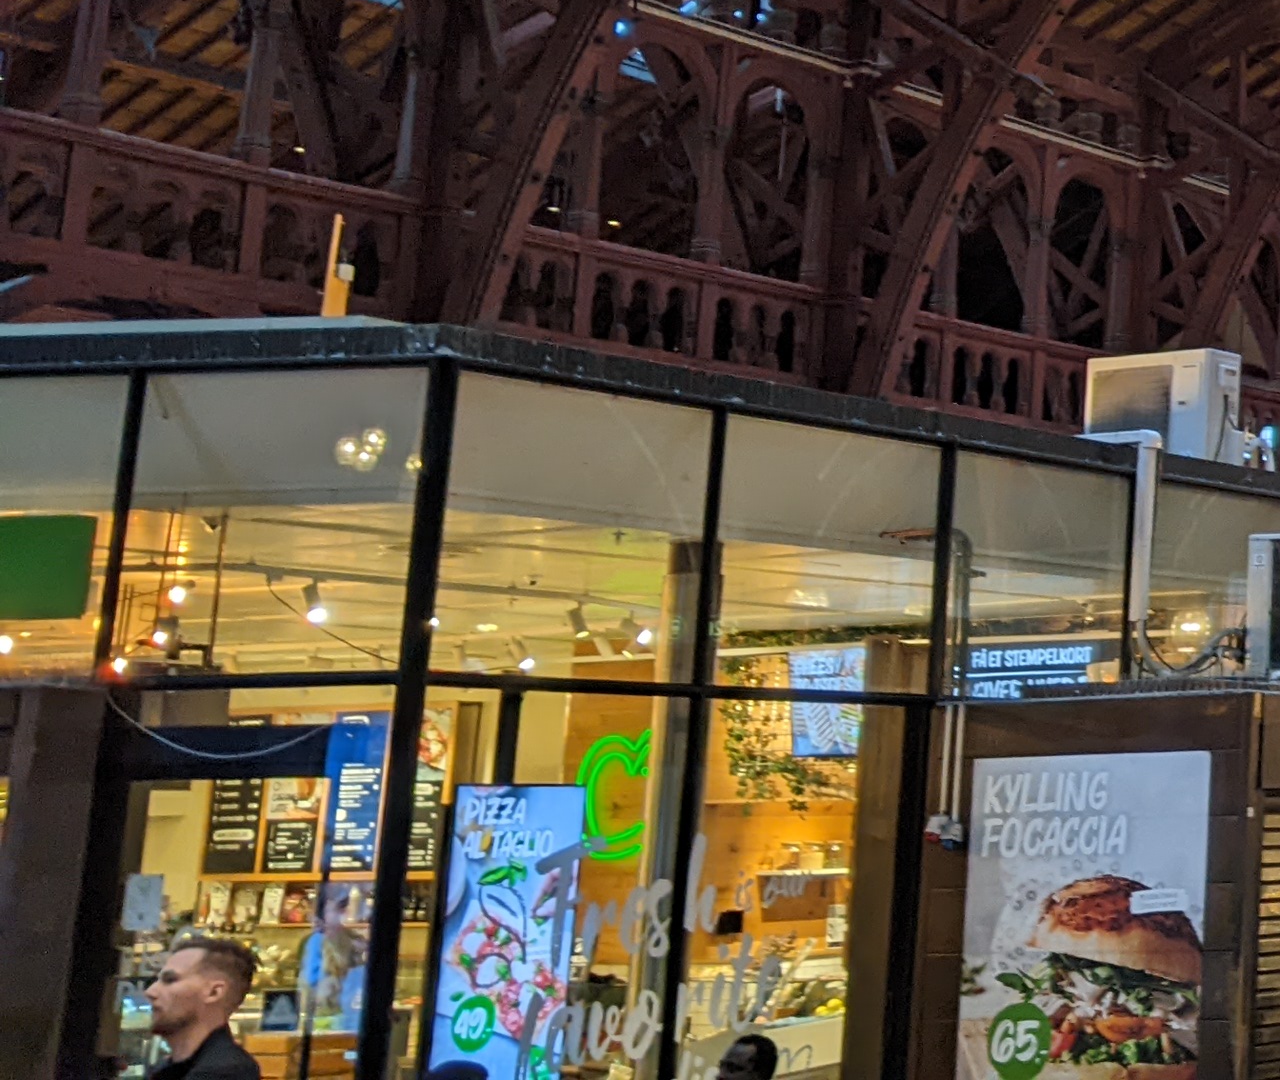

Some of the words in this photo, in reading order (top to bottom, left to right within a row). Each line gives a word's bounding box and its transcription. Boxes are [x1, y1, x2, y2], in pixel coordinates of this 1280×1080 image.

[1004, 647, 1093, 667] STEMPELKORT
[982, 772, 1109, 813] KYLLING
[464, 797, 527, 824] PIZZA
[462, 831, 488, 859] AL
[489, 831, 554, 858] TAGLIO
[981, 815, 1128, 857] FOCACCIA
